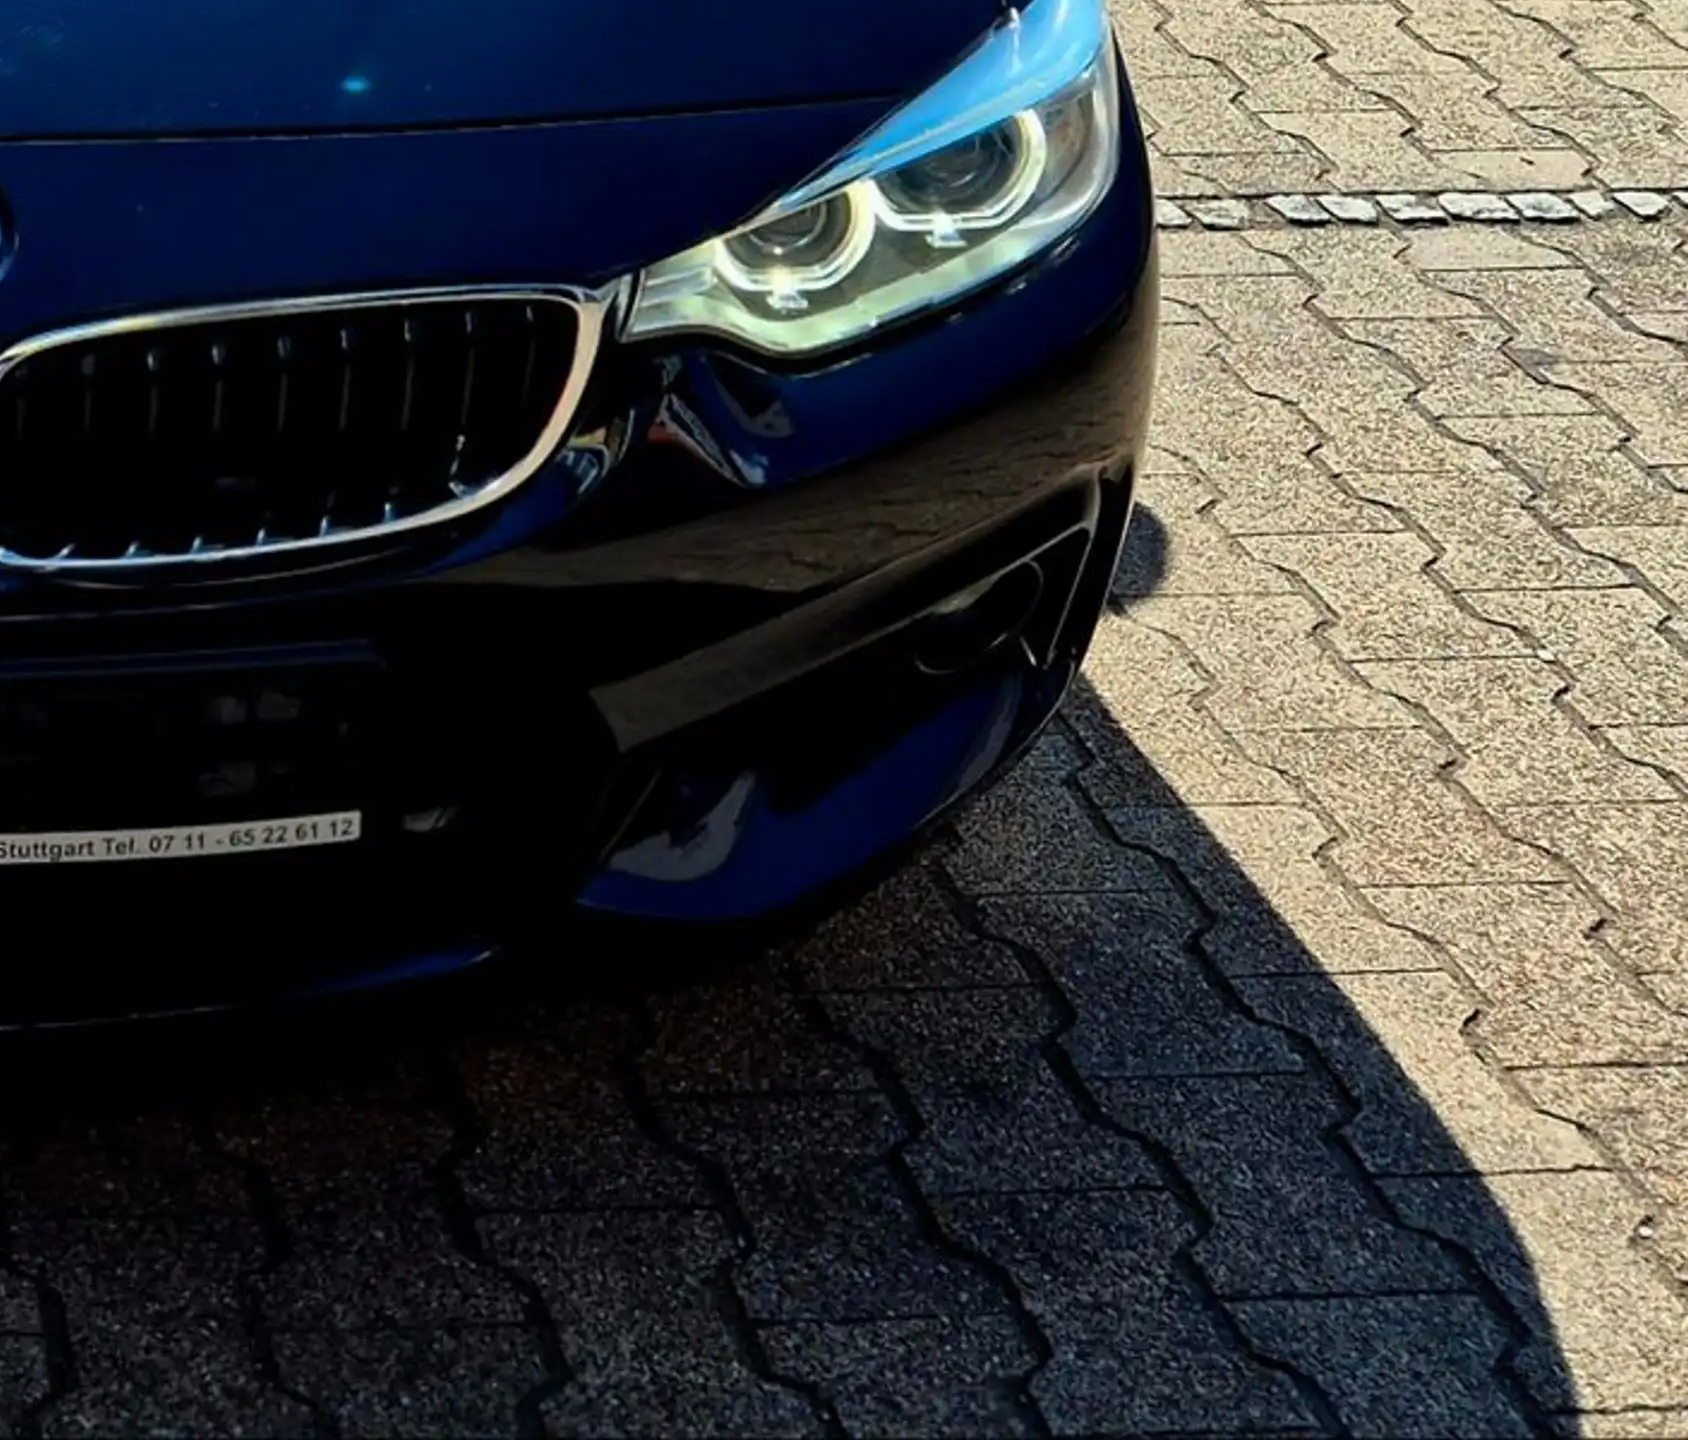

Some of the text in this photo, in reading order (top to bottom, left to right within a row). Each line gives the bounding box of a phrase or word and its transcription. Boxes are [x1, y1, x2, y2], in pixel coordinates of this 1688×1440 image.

[101, 836, 142, 855] Tel.
[148, 834, 175, 854] 07
[183, 832, 205, 850] 11
[229, 827, 255, 847] 65
[262, 825, 288, 844] 22
[295, 821, 318, 841] 61
[329, 817, 354, 837] 12
